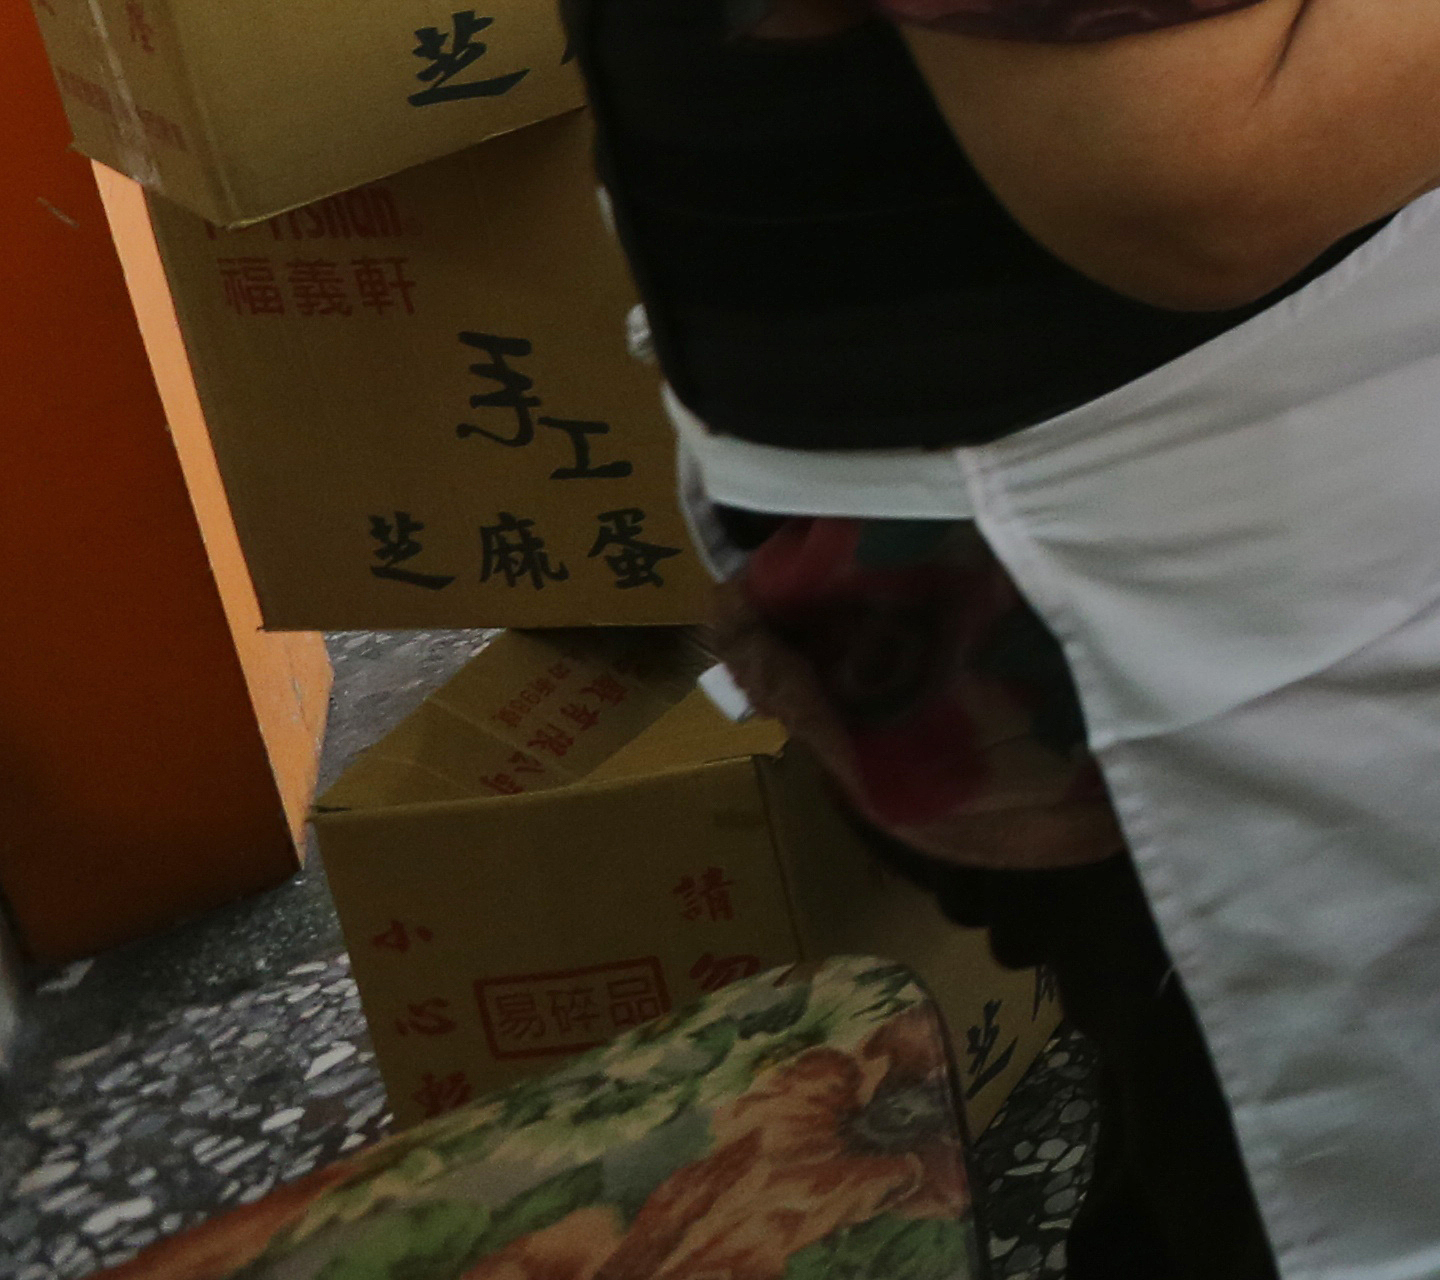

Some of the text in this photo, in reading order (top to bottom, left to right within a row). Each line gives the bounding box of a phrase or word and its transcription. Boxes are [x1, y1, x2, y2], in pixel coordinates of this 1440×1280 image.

[407, 9, 531, 109] 芝
[216, 256, 418, 318] 福義軒
[456, 330, 633, 480] 手工
[368, 506, 683, 592] 芝麻蛋
[494, 978, 663, 1041] 易碎品
